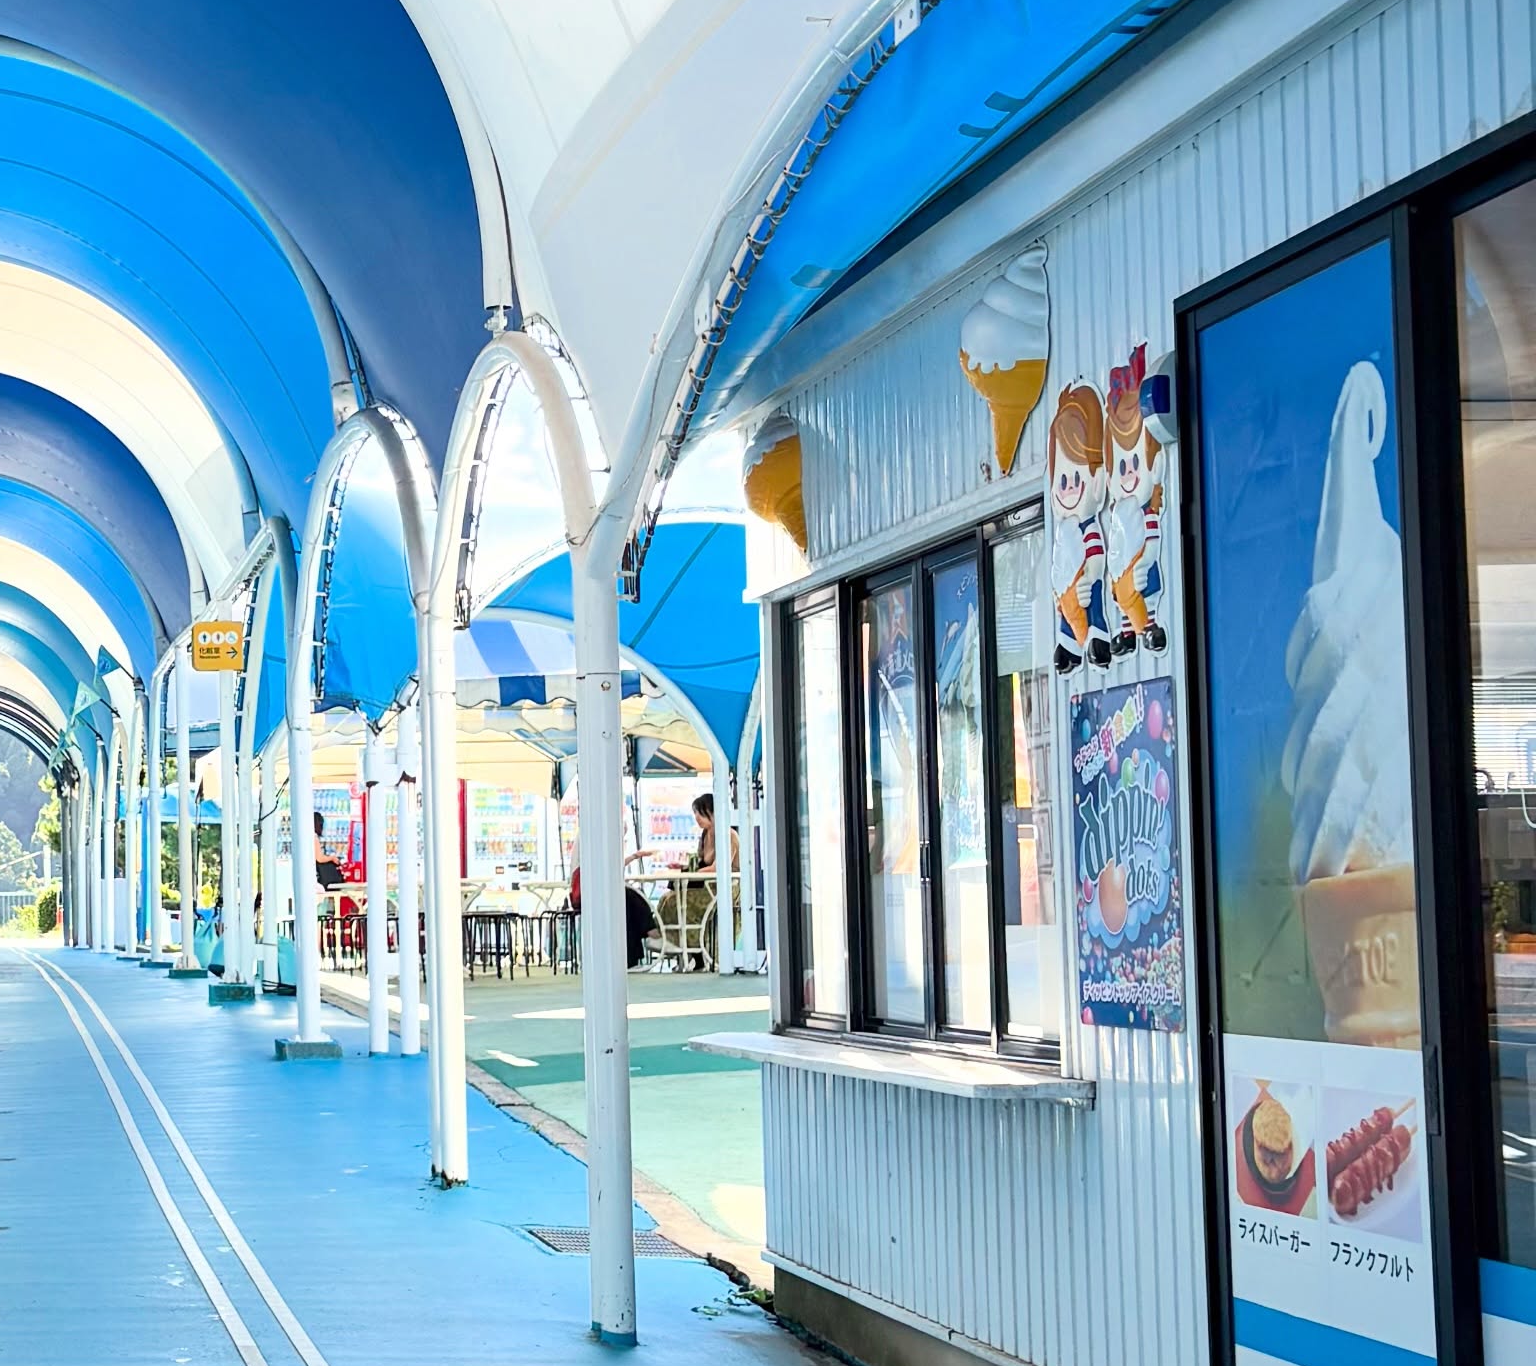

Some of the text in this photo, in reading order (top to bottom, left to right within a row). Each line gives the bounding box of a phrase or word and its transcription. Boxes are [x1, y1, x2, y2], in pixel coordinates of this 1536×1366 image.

[1125, 855, 1159, 905] dots
[1238, 1217, 1311, 1253] ライスバーガー
[1330, 1241, 1414, 1283] フランクフルト
